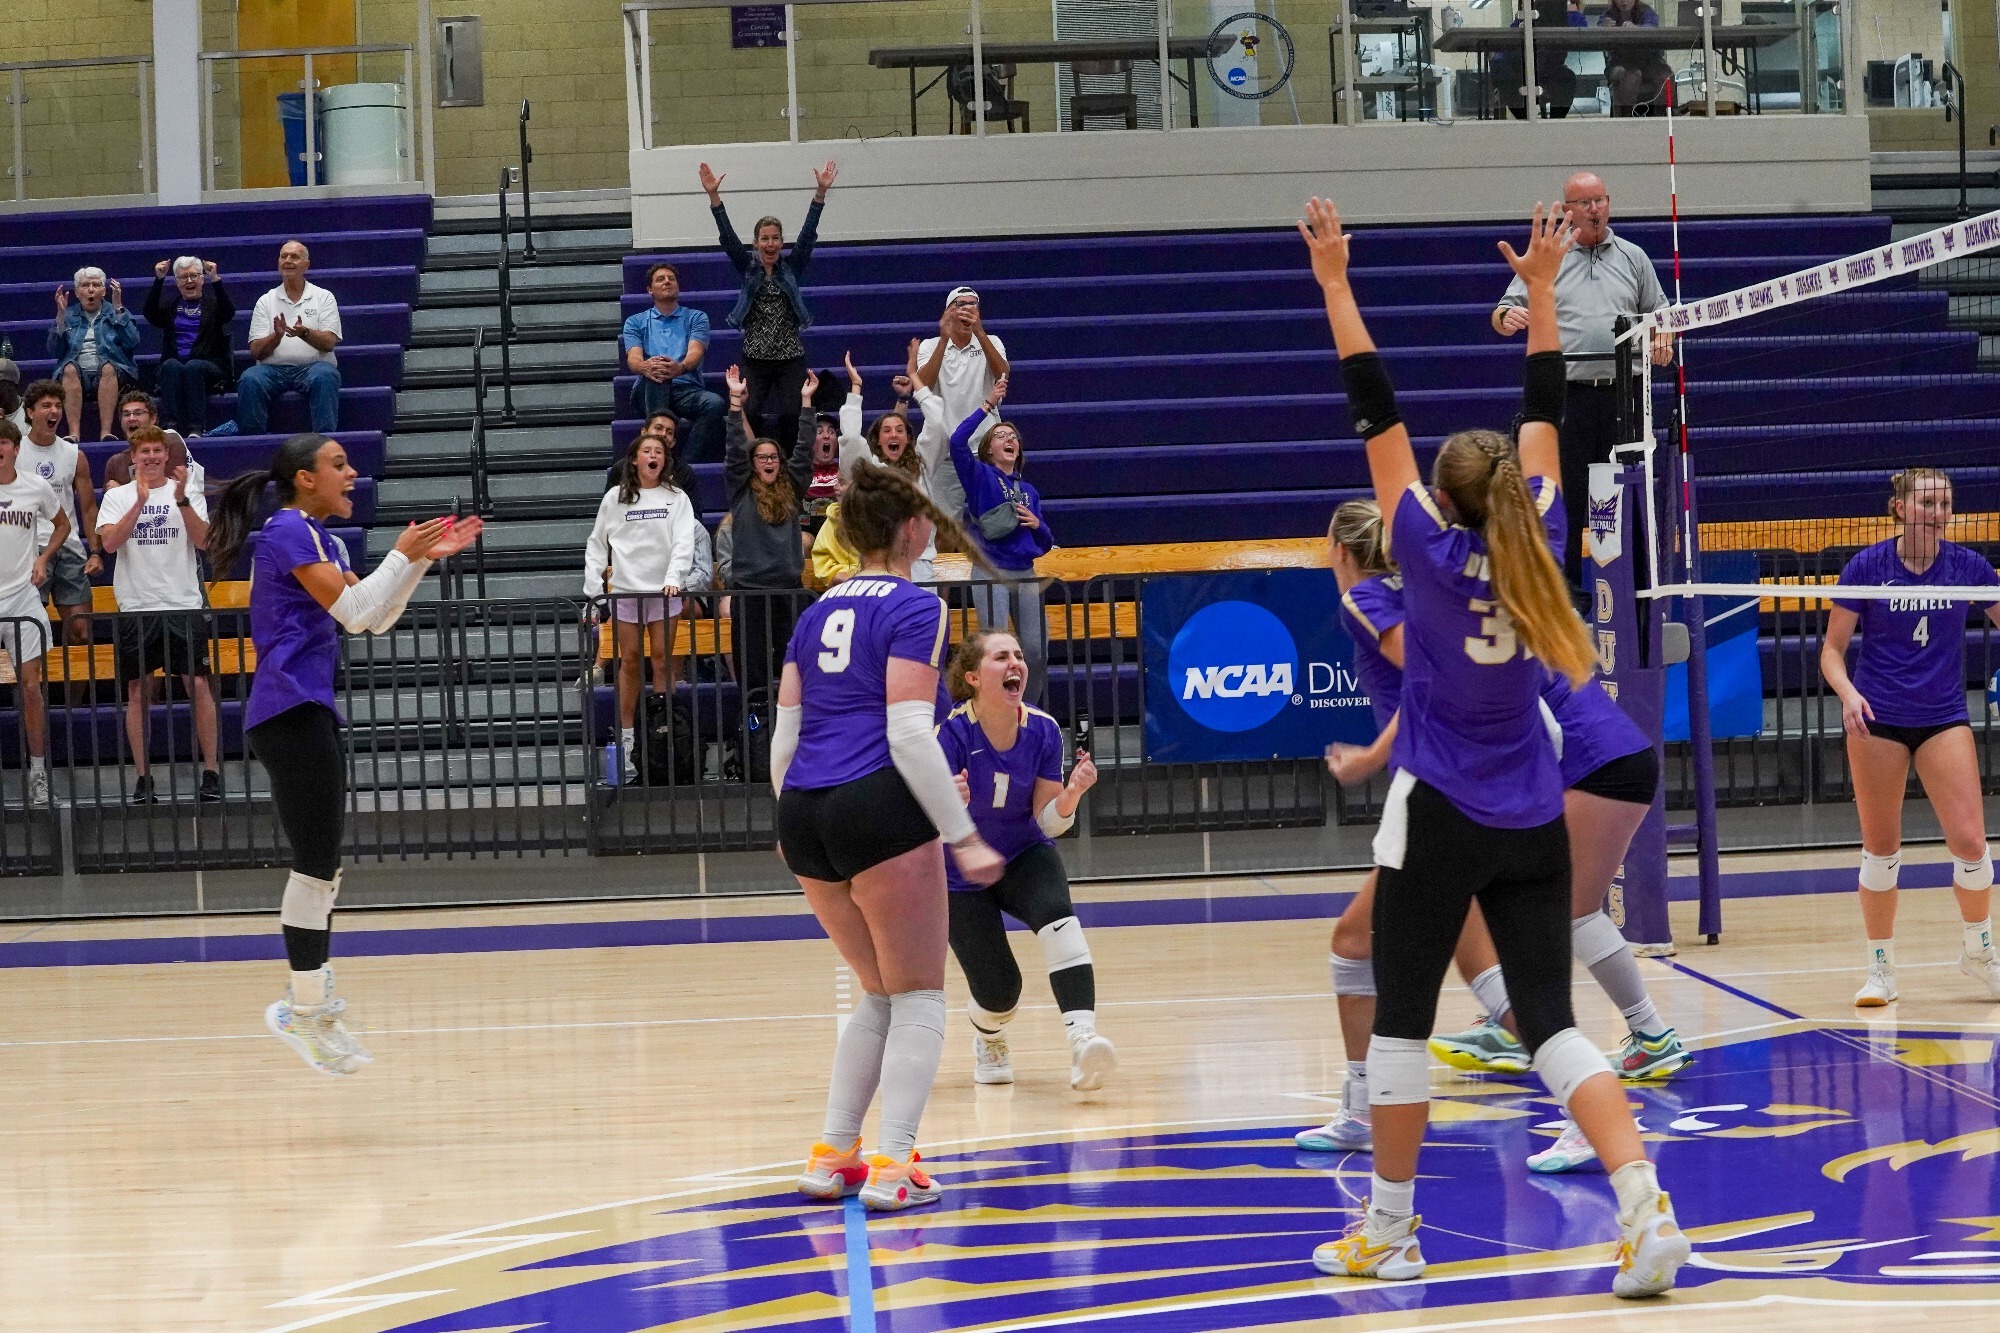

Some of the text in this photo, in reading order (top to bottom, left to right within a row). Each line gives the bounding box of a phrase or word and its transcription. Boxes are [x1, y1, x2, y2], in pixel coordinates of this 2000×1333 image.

[140, 505, 170, 515] ORAS
[149, 527, 180, 538] COUNTRY
[1889, 598, 1953, 612] CORNELL
[818, 608, 855, 673] 9
[1464, 598, 1535, 665] 3
[1912, 615, 1930, 647] 4
[1183, 661, 1360, 700] NCAA Div
[1309, 697, 1371, 709] DISCOVER
[992, 771, 1010, 808] 1
